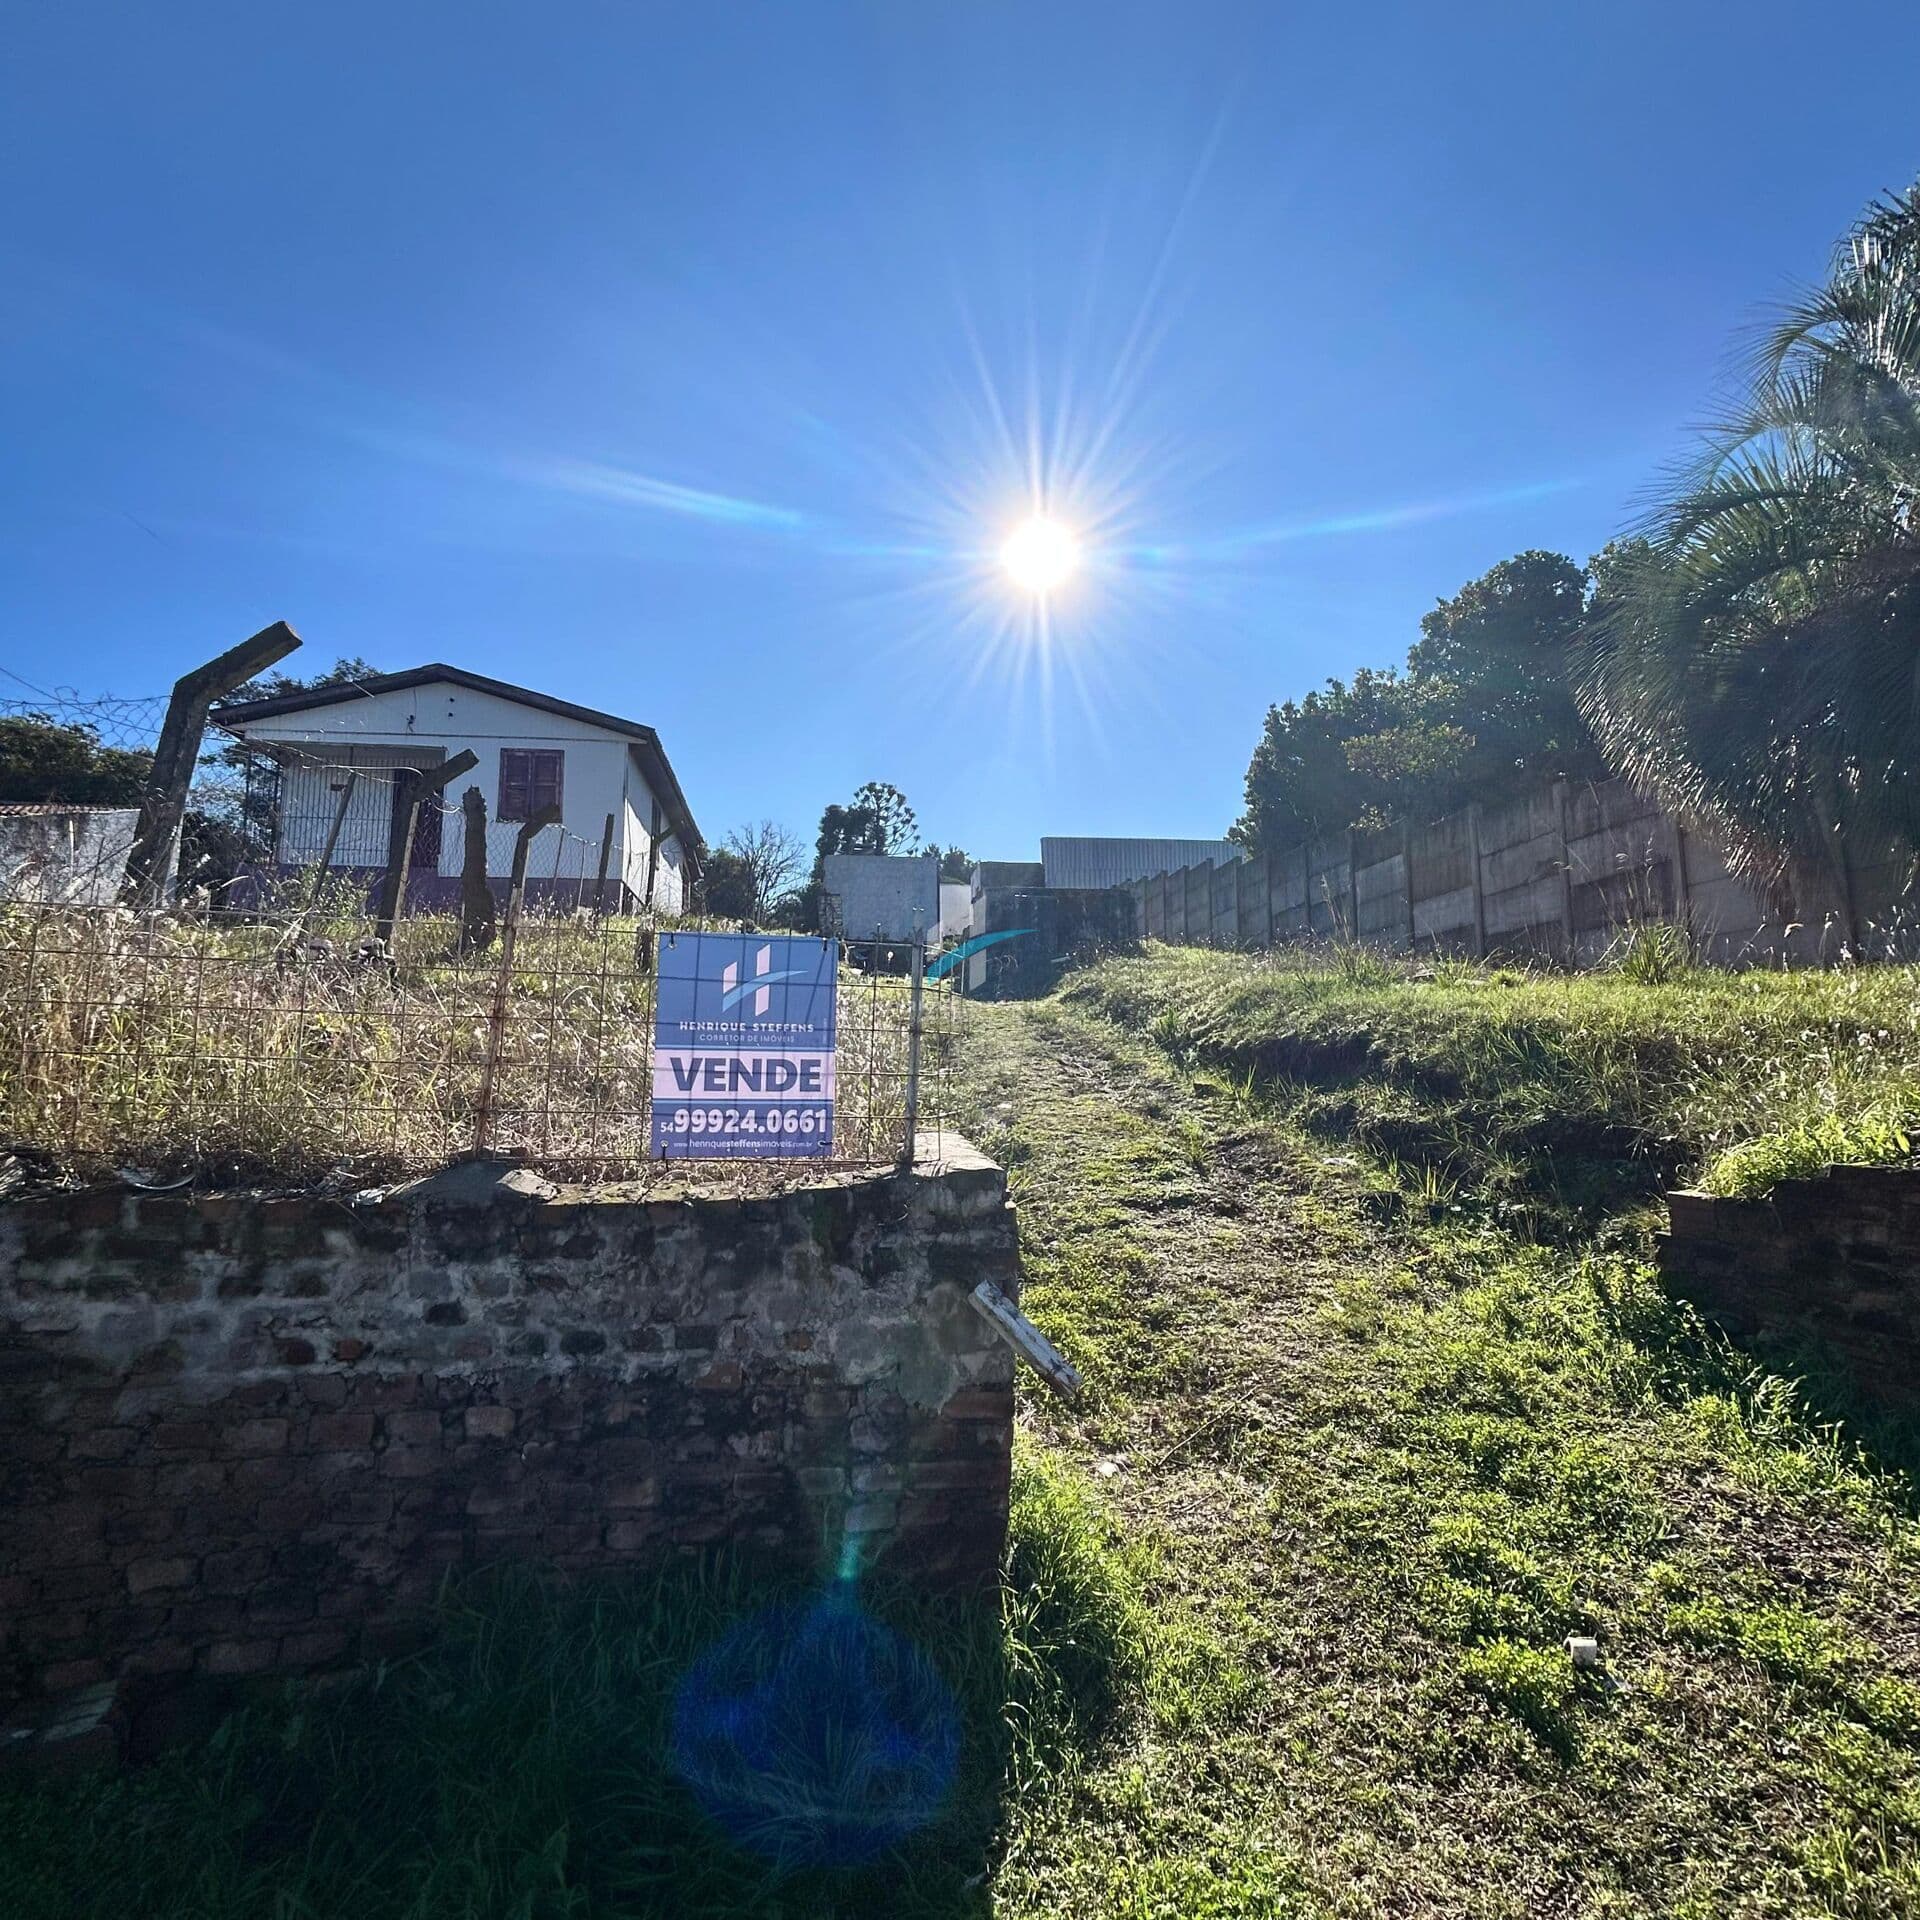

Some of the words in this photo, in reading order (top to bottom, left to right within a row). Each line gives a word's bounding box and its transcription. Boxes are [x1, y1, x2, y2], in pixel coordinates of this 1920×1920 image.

[679, 1021, 746, 1032] HENRIQUE
[752, 1023, 814, 1033] STEFFENS
[699, 1033, 745, 1042] CORRETOR
[747, 1034, 759, 1043] DE
[670, 1056, 821, 1093] VENDE
[674, 1108, 827, 1134] 99924.0661
